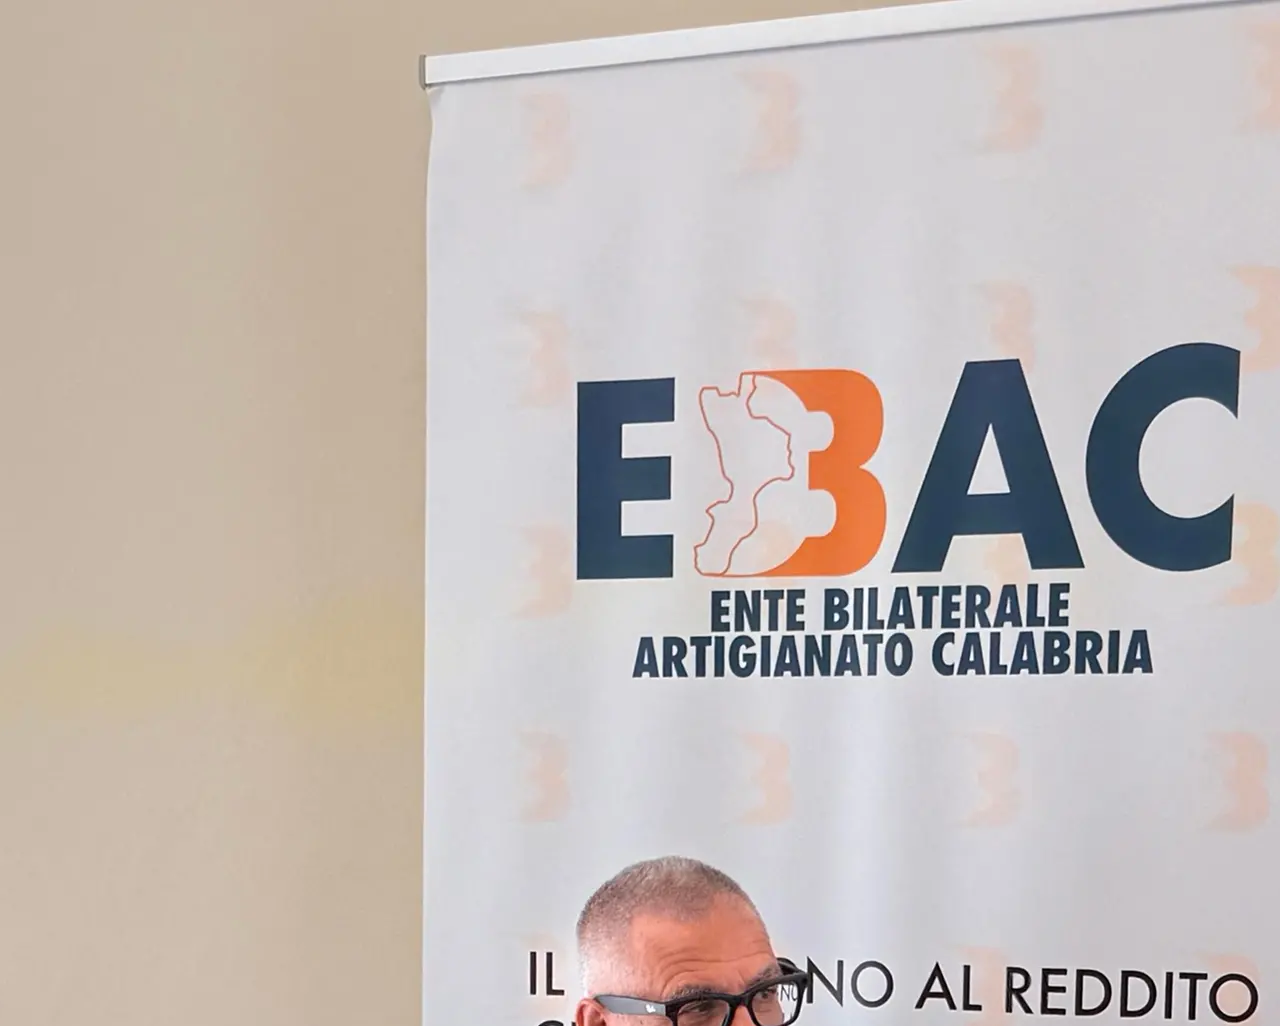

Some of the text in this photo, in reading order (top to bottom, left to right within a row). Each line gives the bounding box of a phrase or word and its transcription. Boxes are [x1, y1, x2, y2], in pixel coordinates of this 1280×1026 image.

[576, 342, 1241, 580] EBAC
[711, 582, 1071, 633] ENTE BILATERALE
[632, 629, 1154, 679] ARTIGIANATO CALABRIA
[528, 950, 566, 997] IL
[914, 961, 984, 1013] AL
[1005, 966, 1260, 1025] REDDITO
